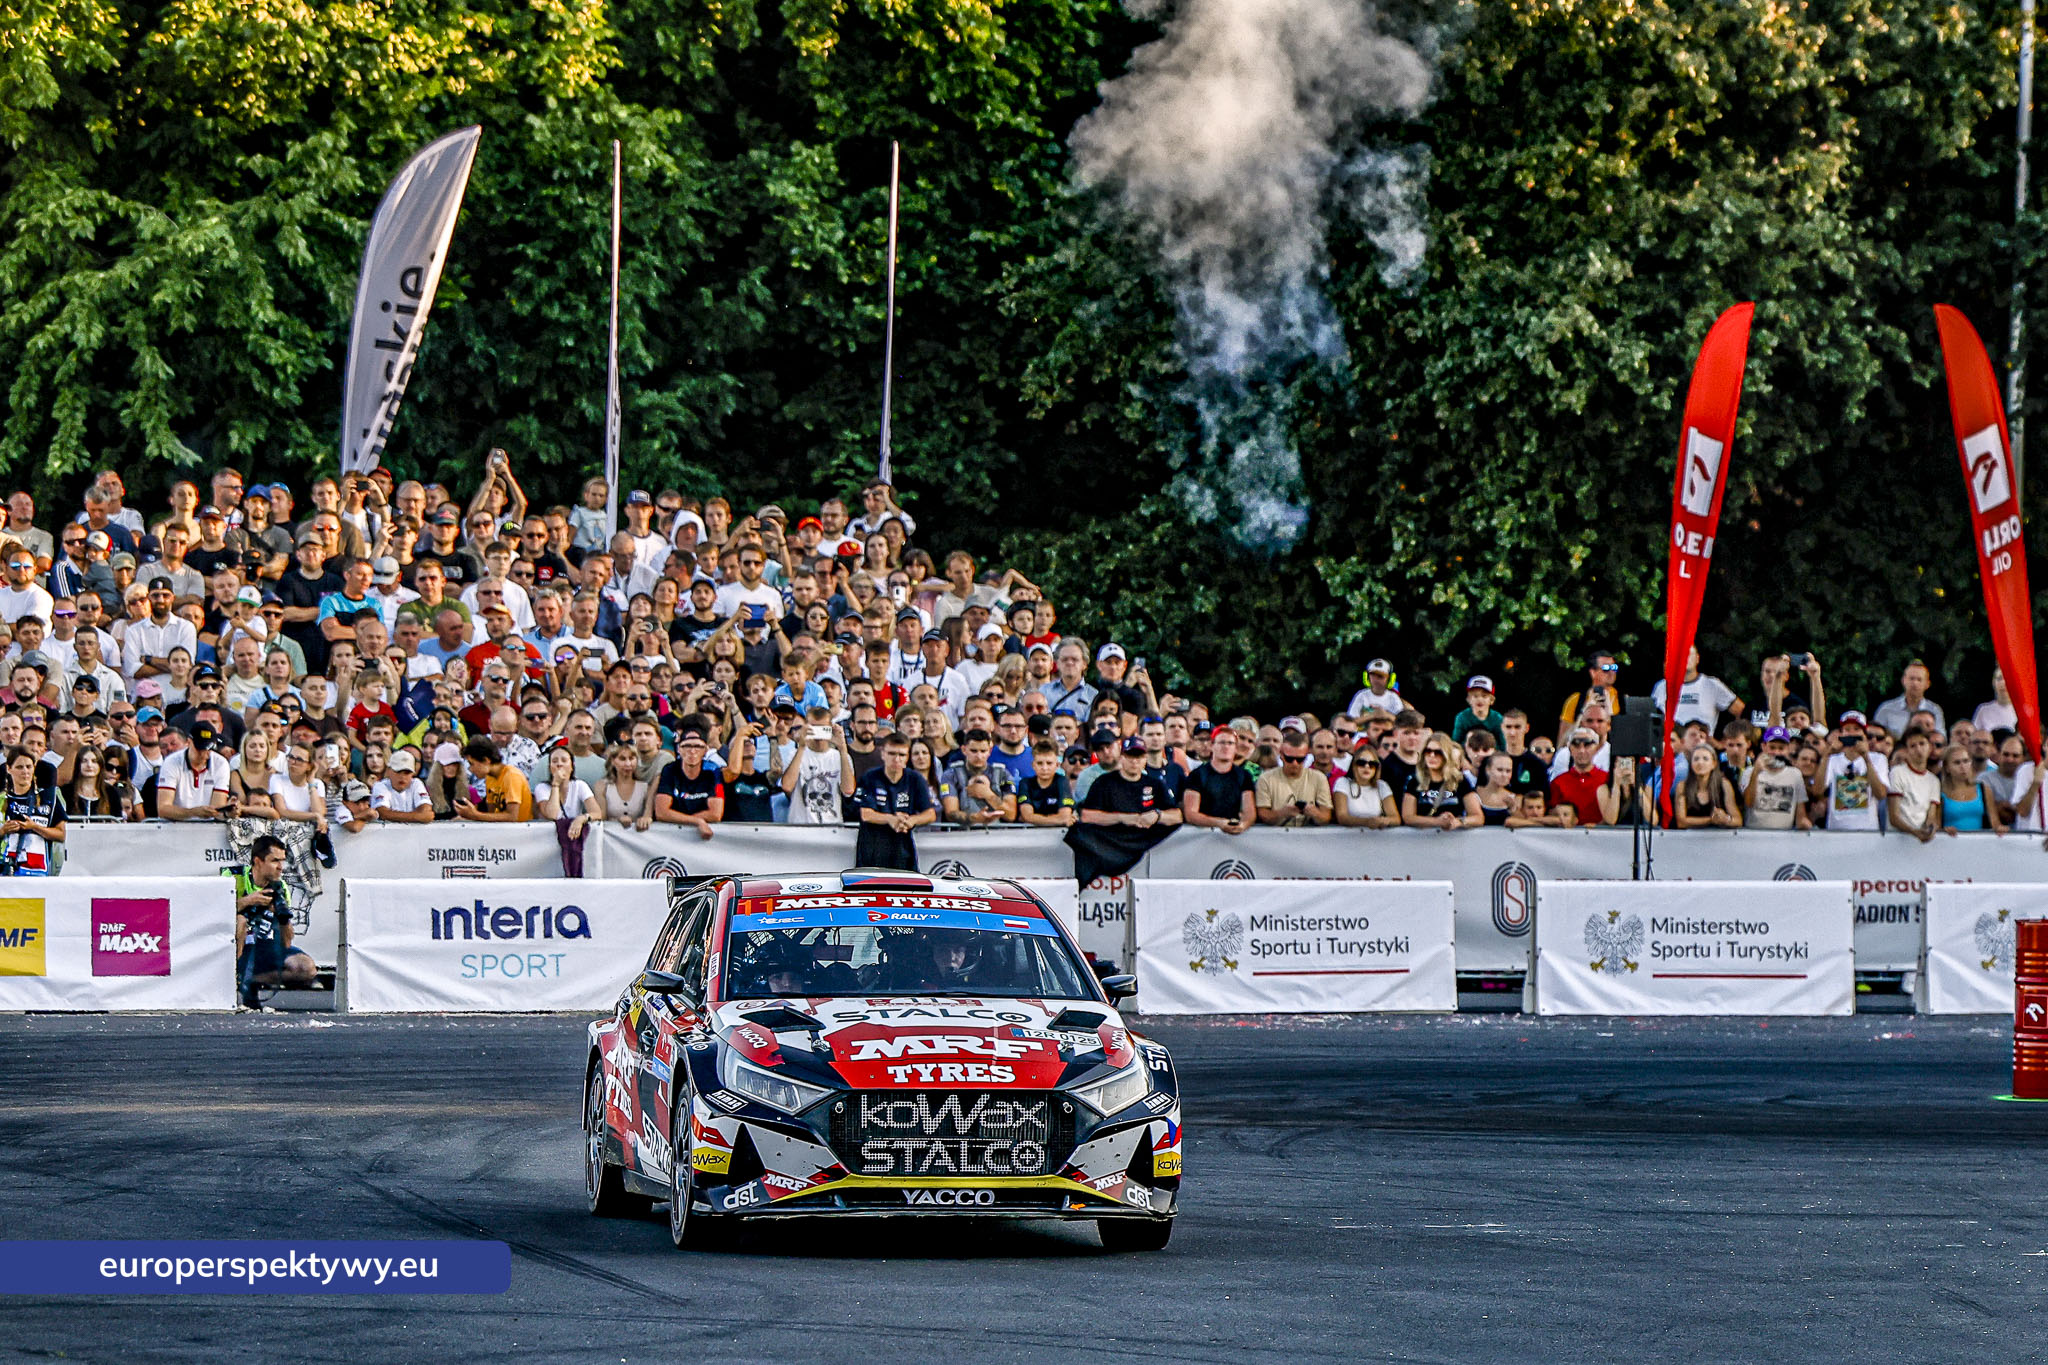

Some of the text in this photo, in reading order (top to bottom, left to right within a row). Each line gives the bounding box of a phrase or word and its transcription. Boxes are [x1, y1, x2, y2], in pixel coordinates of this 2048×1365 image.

[428, 845, 517, 865] STADION ŚLĄSKI
[738, 896, 992, 916] 11 MRF TYRES
[1855, 903, 1910, 923] ADION
[99, 922, 126, 933] RMF
[431, 899, 592, 940] interia
[1250, 914, 1369, 931] Ministerstwo
[1651, 916, 1770, 935] Ministerstwo
[0, 928, 38, 948] MF
[100, 932, 163, 953] MAXX
[1250, 936, 1410, 958] Sportu i Turystyki
[1651, 940, 1808, 962] Sportu i Turystyki
[461, 954, 566, 978] SPORT
[832, 1008, 1032, 1023] STALCO
[737, 1027, 768, 1049] YACCO
[1024, 1030, 1097, 1045] 12R 0125
[850, 1035, 1043, 1061] MRF
[887, 1063, 1016, 1083] TYRES
[693, 1153, 726, 1166] oWax
[861, 1140, 1045, 1172] STALCO
[764, 1173, 807, 1192] MRF
[1094, 1171, 1126, 1191] MRF
[723, 1181, 759, 1209] dst
[902, 1189, 995, 1206] YACCO
